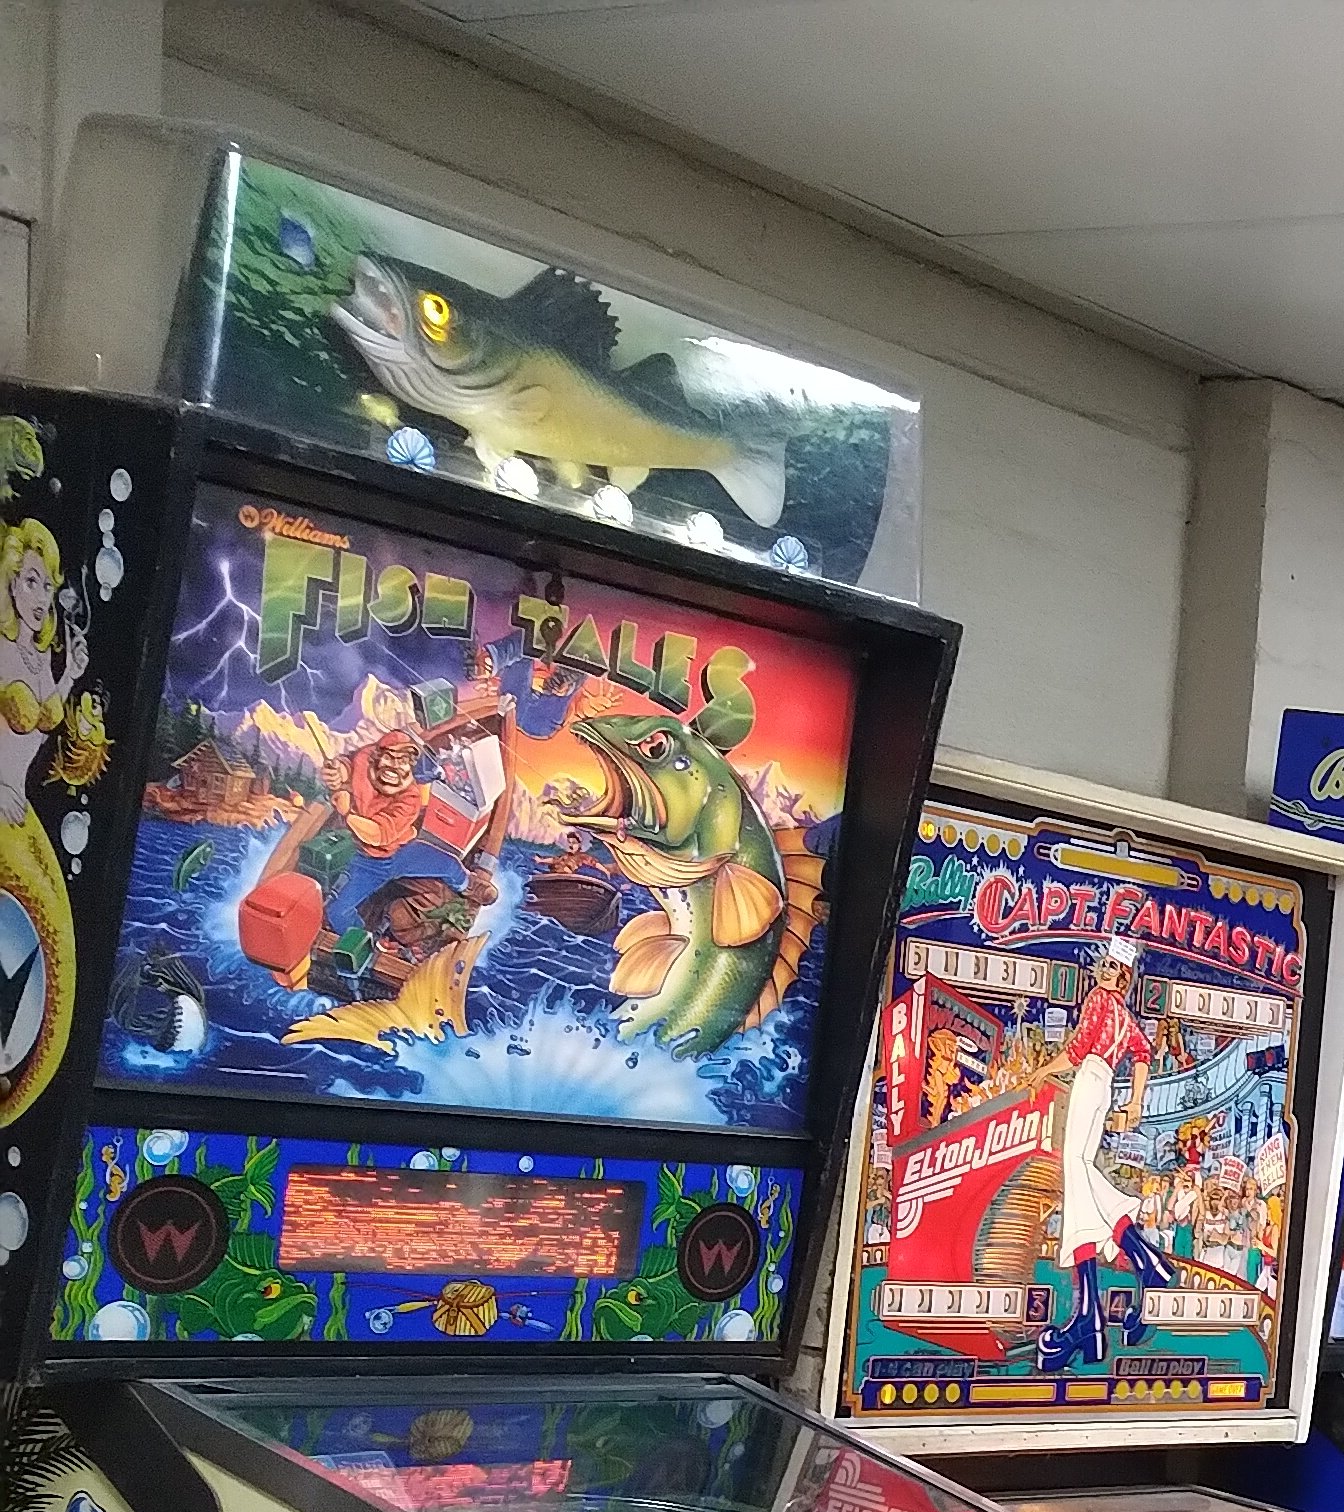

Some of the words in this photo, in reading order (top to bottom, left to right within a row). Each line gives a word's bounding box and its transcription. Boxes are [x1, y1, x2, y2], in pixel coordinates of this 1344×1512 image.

[260, 508, 350, 549] Williams
[257, 532, 477, 686] FISH
[509, 595, 756, 758] TALES
[899, 854, 978, 913] Bally
[1103, 886, 1303, 987] FANTASTIC
[890, 1002, 908, 1136] BALLY
[1118, 1357, 1149, 1376] Ball
